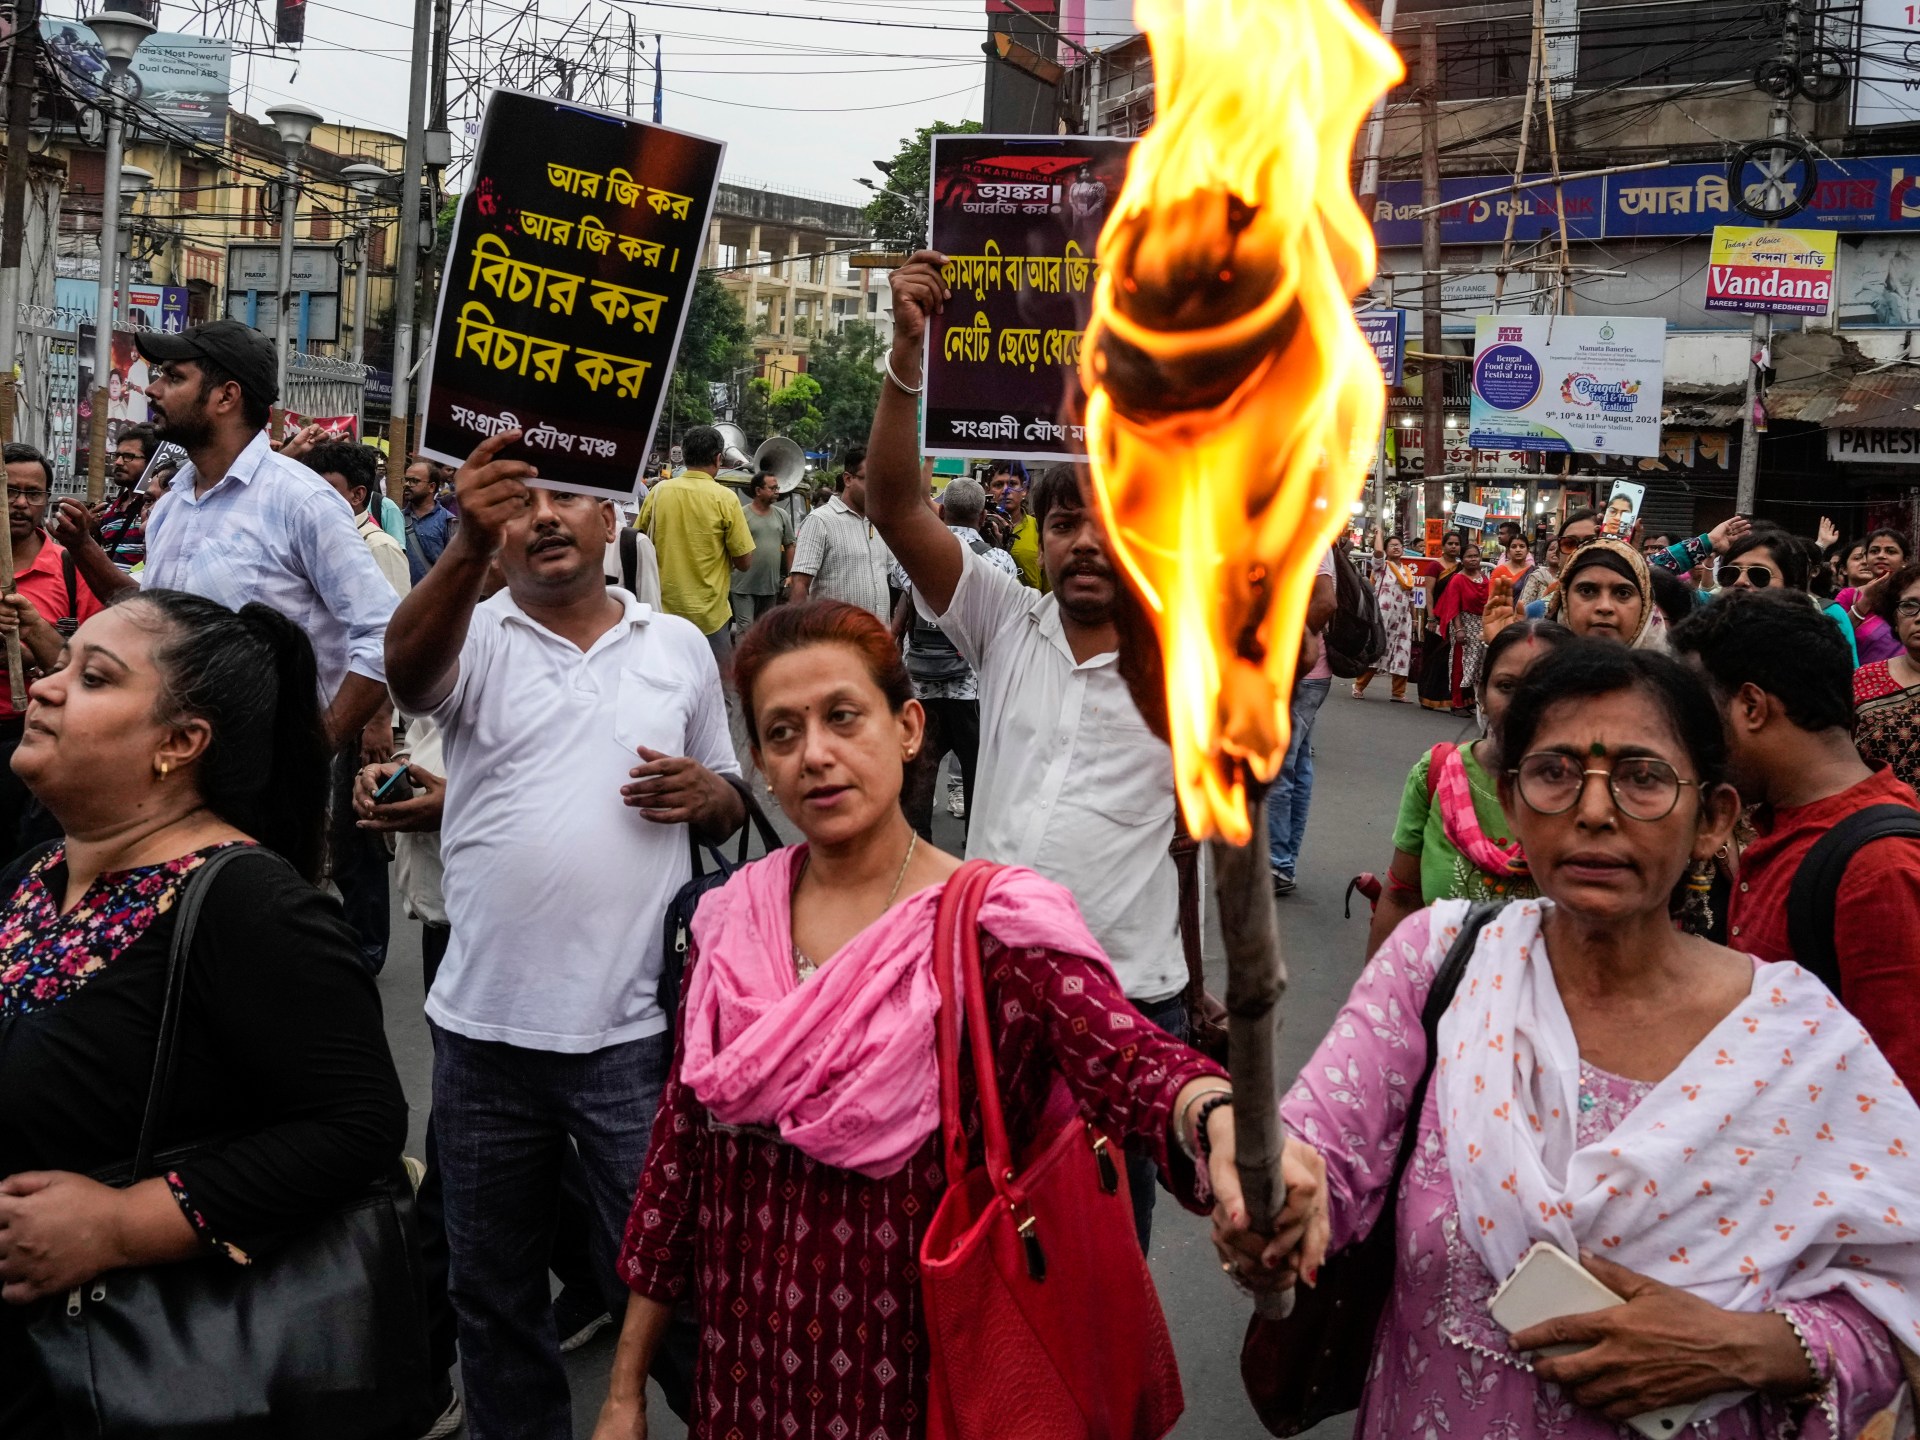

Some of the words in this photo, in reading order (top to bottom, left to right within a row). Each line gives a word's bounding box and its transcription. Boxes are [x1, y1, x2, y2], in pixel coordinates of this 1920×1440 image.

[1905, 5, 1920, 25] 1
[136, 47, 162, 56] ndia's
[164, 48, 186, 58] Most
[188, 51, 226, 62] Powerful
[138, 64, 160, 72] Dual
[162, 66, 198, 76] Channel
[200, 70, 218, 78] ABS
[548, 162, 604, 199] আর
[606, 168, 644, 208] জি
[646, 187, 694, 221] কর
[1619, 186, 1694, 215] আর
[1696, 175, 1730, 213] বি
[962, 199, 1018, 214] আরজি
[1022, 203, 1050, 214] কর
[1496, 200, 1535, 216] RBL
[1536, 198, 1594, 215] BANK
[520, 210, 574, 246] আর
[576, 215, 616, 256] জি
[1721, 238, 1752, 250] Today's
[1756, 236, 1782, 246] Choice
[1752, 252, 1788, 264] বন্দনা
[1793, 250, 1826, 267] শাড়ি
[940, 239, 1003, 302] কামদুনি
[1004, 256, 1024, 292] বা
[1026, 257, 1062, 294] আর
[1064, 240, 1090, 294] জি
[468, 233, 586, 316] বিচার
[590, 279, 669, 334] কর
[1712, 266, 1829, 300] Vandana
[1772, 304, 1816, 312] BEDSHEETS
[1498, 326, 1522, 334] ENTRY
[1498, 334, 1522, 342] FREE
[455, 300, 570, 384] বিচার
[575, 348, 652, 399] কর
[944, 310, 992, 362] নেংটি
[998, 328, 1041, 373] ছেড়ে
[1485, 362, 1504, 370] Food
[1496, 354, 1522, 363] Bengal
[1484, 370, 1512, 378] Festival
[1574, 378, 1621, 394] Bengal
[1590, 392, 1608, 402] Food
[1618, 394, 1638, 403] Fruit
[1601, 402, 1634, 412] Festival
[1560, 412, 1576, 420] 10th
[1576, 412, 1582, 420] &
[1602, 414, 1634, 424] August,
[1636, 416, 1658, 424] 2024
[950, 414, 1020, 440] সংগ্রামী
[1024, 418, 1068, 442] যৌথ
[524, 422, 576, 452] যৌথ
[579, 436, 618, 458] মঞ্চ
